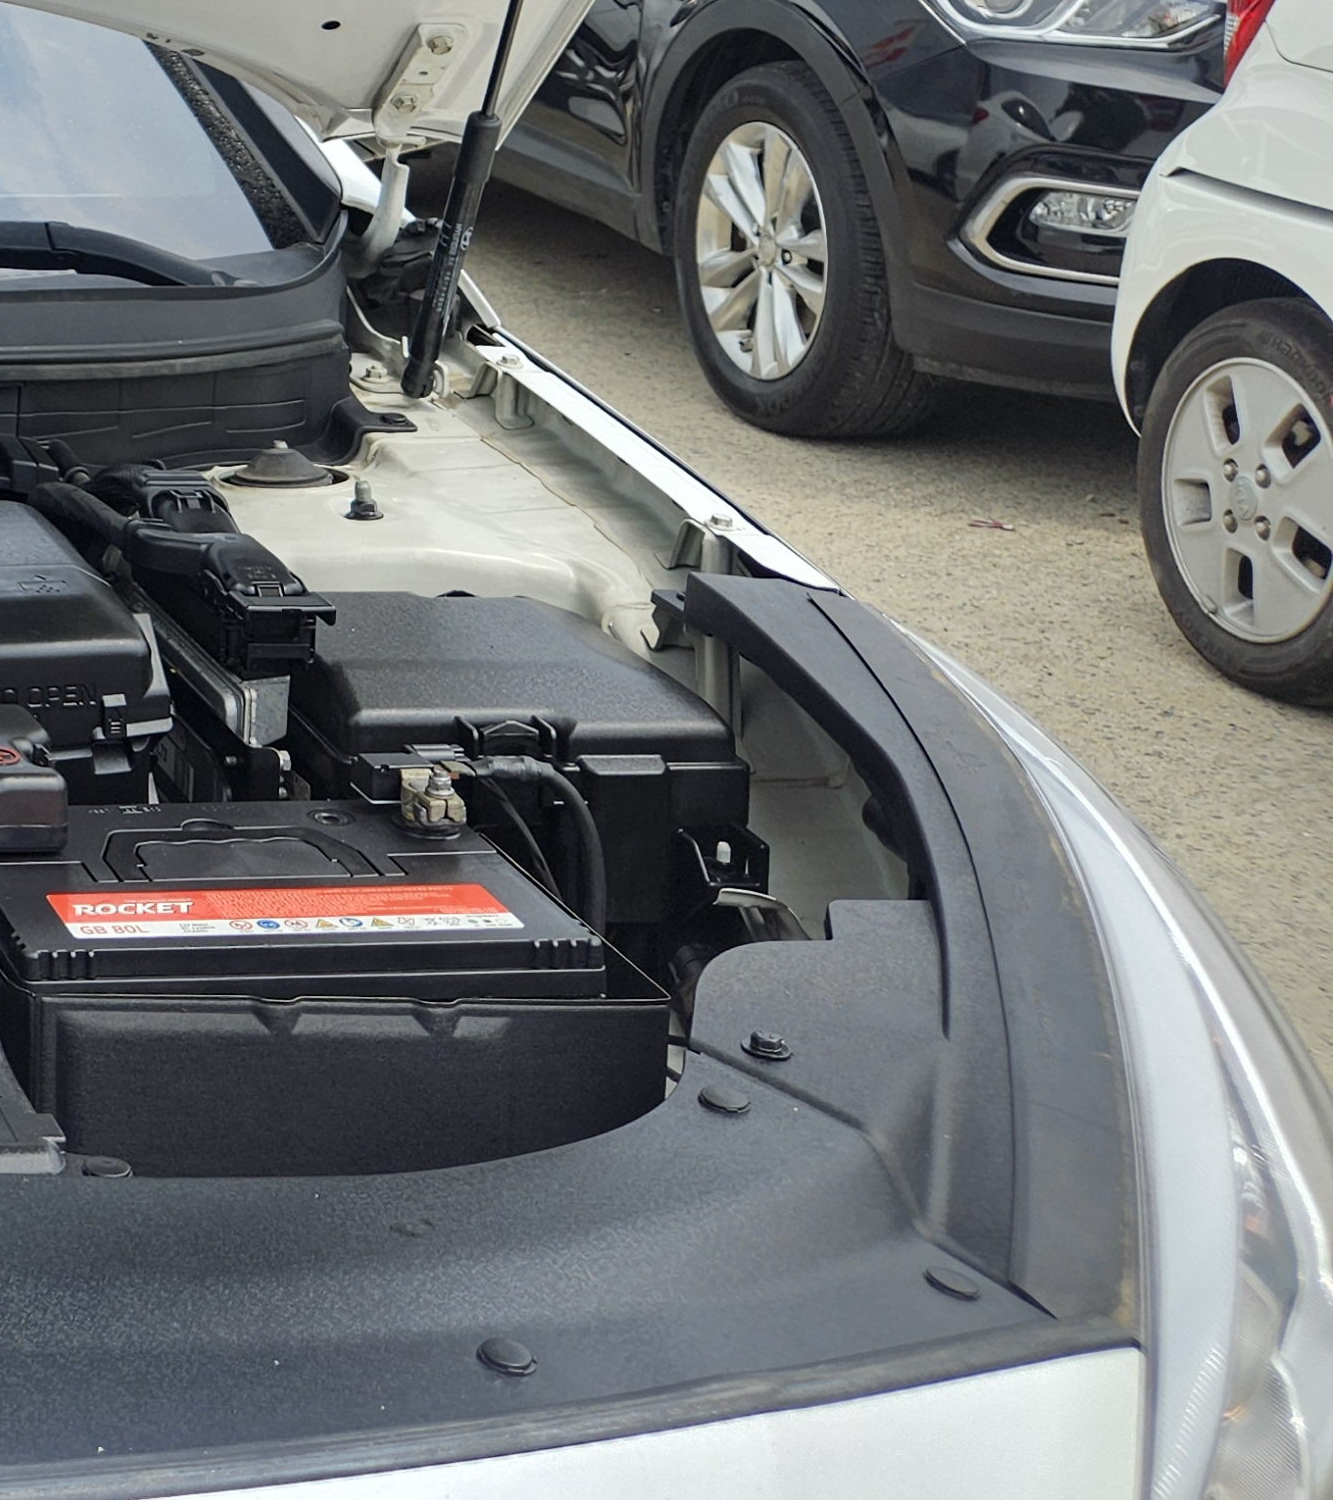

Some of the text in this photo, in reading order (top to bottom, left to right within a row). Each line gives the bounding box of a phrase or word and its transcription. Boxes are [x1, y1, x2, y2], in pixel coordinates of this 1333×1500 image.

[26, 682, 97, 708] OPEN
[71, 901, 194, 917] ROCKET
[79, 924, 150, 936] GB 80L
